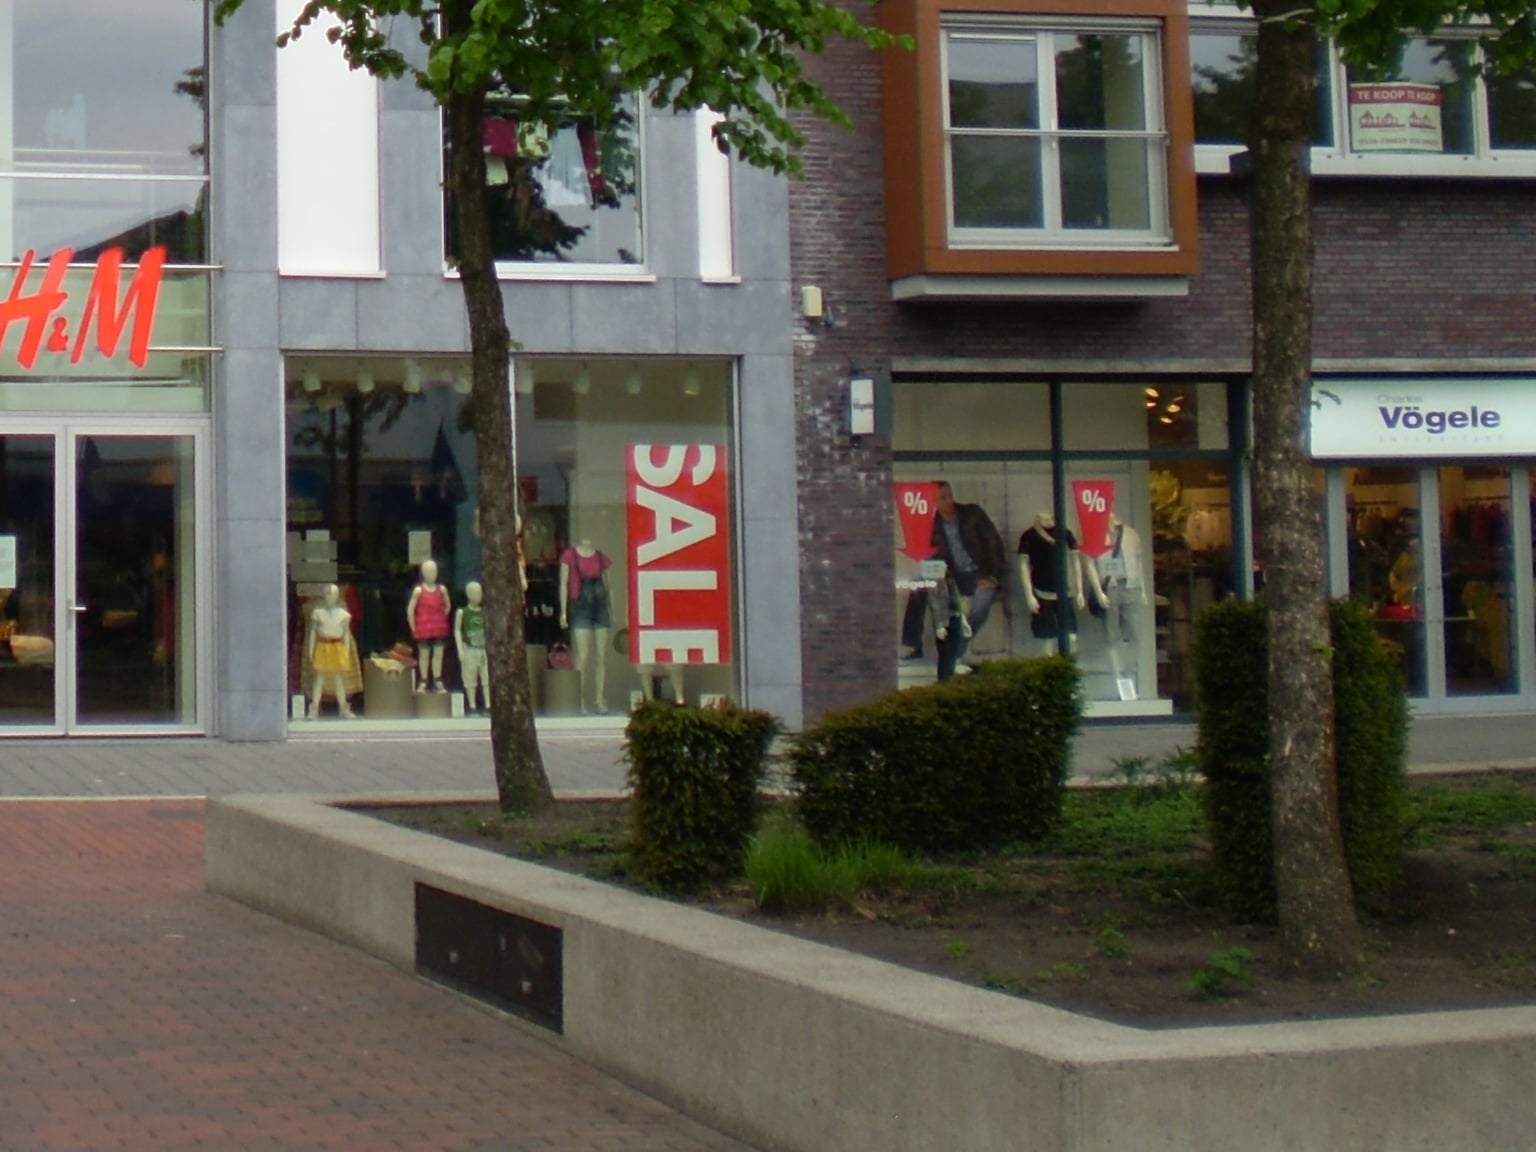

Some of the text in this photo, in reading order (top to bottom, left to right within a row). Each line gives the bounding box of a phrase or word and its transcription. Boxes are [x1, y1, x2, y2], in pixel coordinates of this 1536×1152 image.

[1357, 91, 1371, 100] TE
[1373, 90, 1406, 100] KOOP
[1378, 405, 1501, 434] Vögele
[904, 491, 928, 515] %
[1082, 489, 1106, 513] %
[634, 444, 720, 665] SALE
